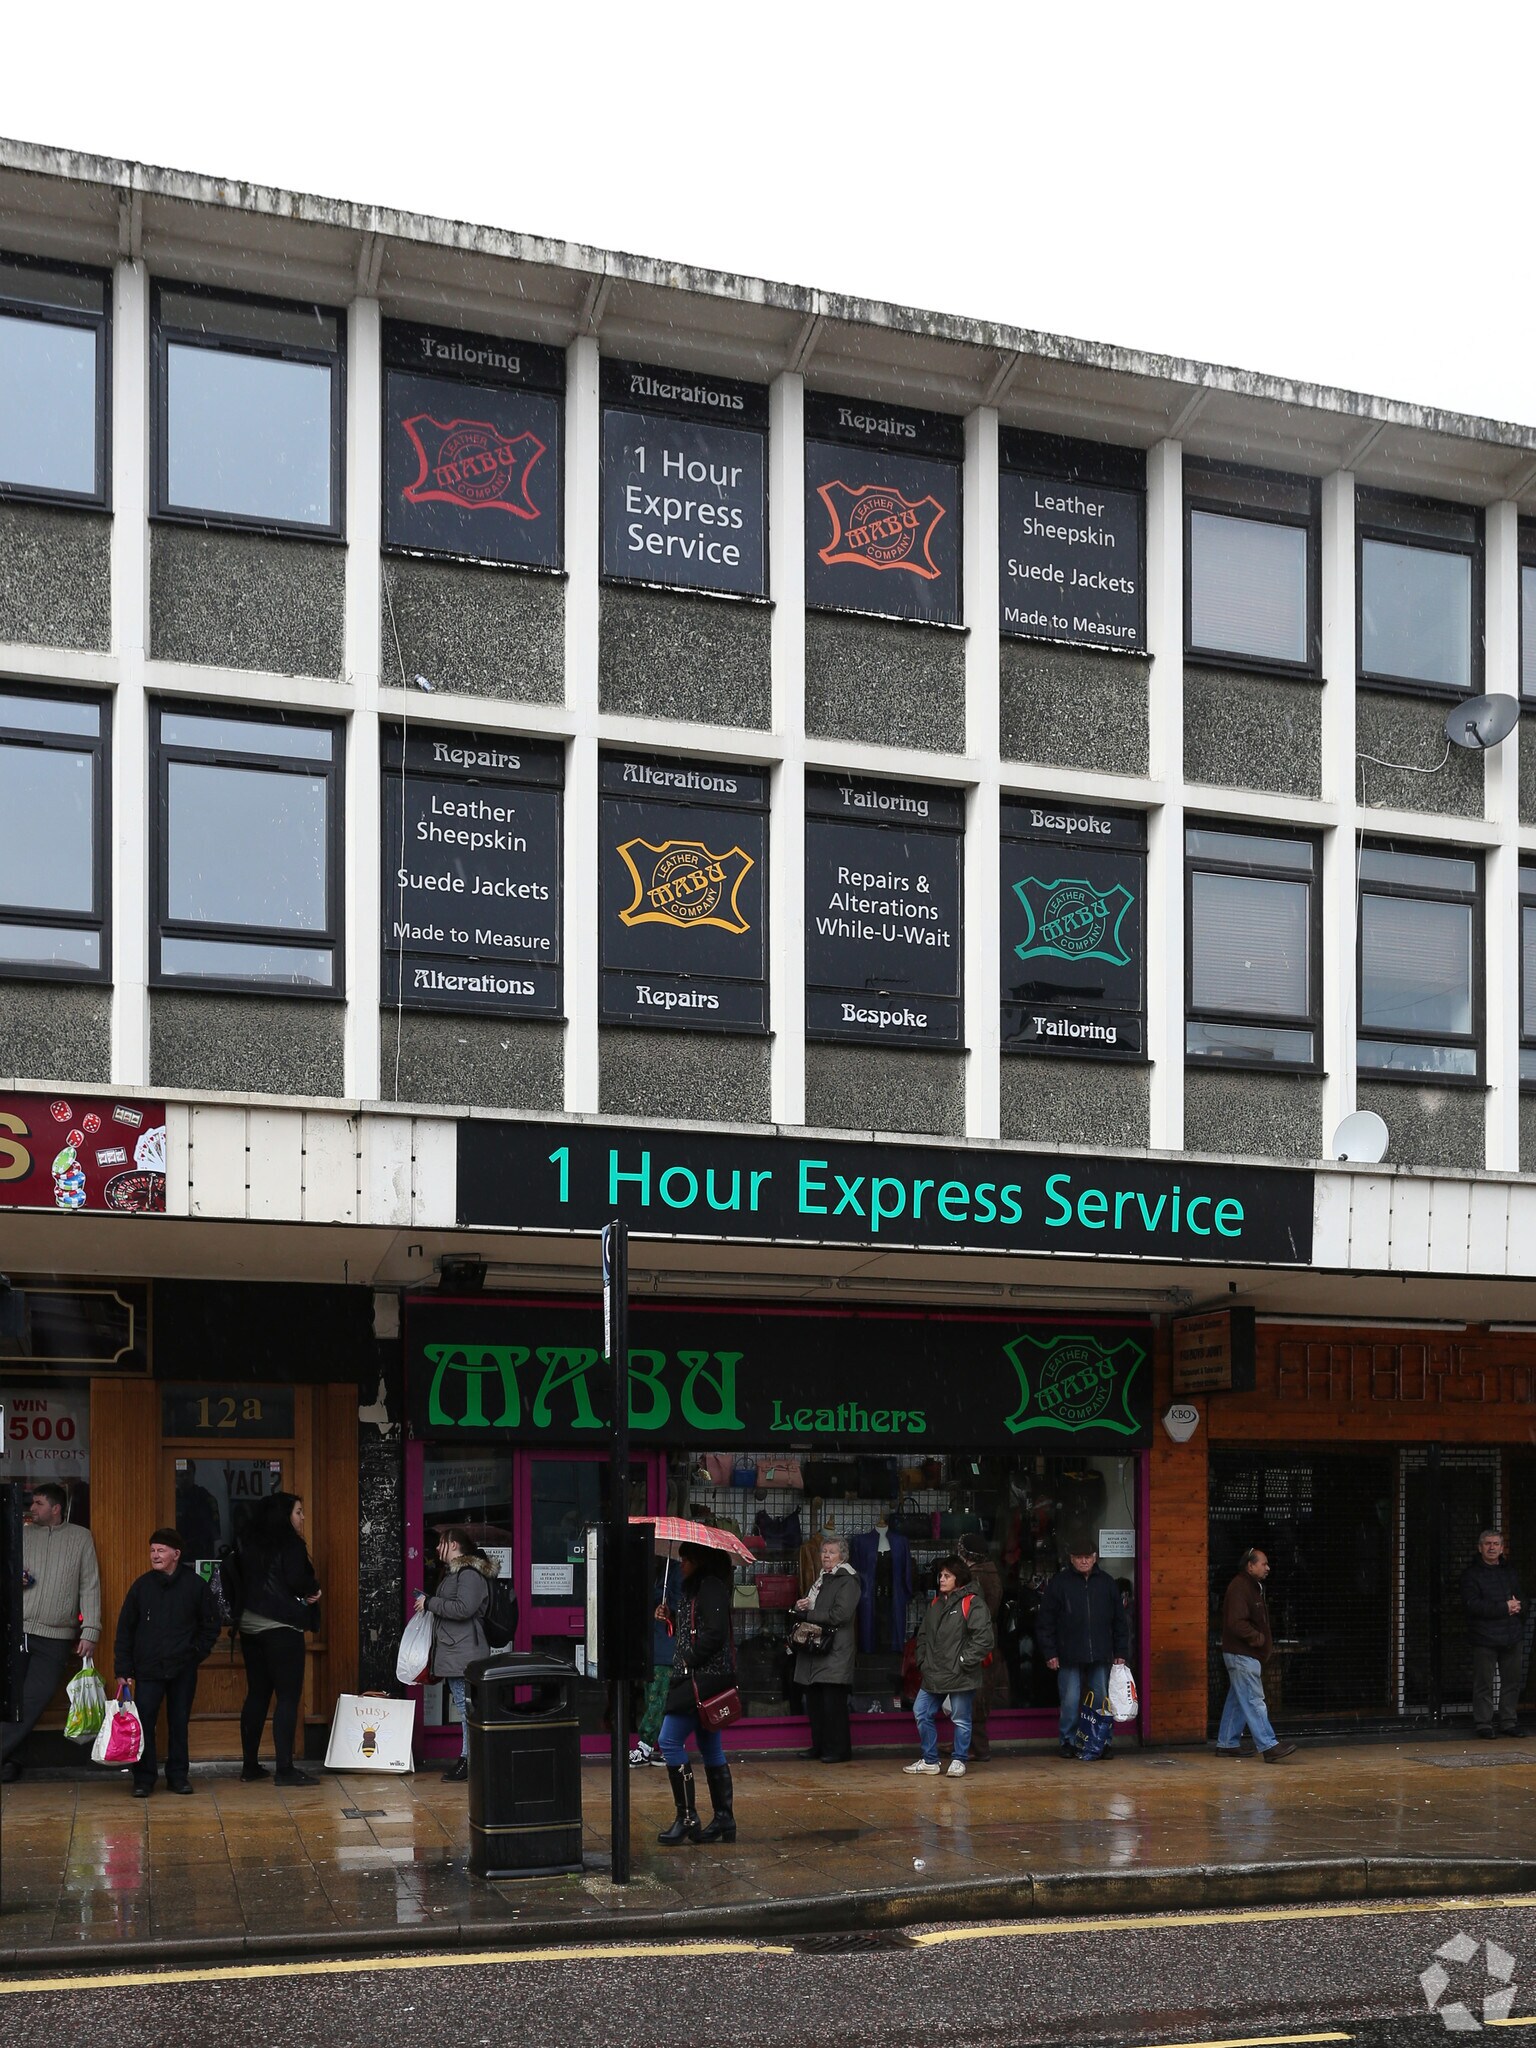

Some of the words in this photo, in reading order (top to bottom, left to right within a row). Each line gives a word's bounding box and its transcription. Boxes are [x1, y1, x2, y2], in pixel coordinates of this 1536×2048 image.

[420, 337, 521, 374] Tailoring
[629, 374, 745, 410] Alterations
[838, 408, 917, 438] Repairs
[444, 434, 488, 457] LEATHER
[432, 445, 518, 487] MABU
[634, 446, 646, 474] 1
[663, 452, 743, 489] Hour
[458, 471, 506, 498] COMPANY
[625, 485, 744, 530] Express
[854, 499, 894, 521] LEATHER
[1034, 491, 1105, 519] Leather
[844, 508, 920, 549] MABU
[1023, 517, 1116, 549] Sheepskin
[627, 524, 741, 567] Service
[867, 533, 911, 560] COMPANY
[1007, 558, 1065, 584] Suede
[1070, 564, 1136, 595] Jackets
[1004, 606, 1048, 628] Made
[1051, 614, 1069, 630] to
[1073, 615, 1137, 639] Measure
[433, 742, 521, 770] Repairs
[622, 763, 738, 794] Alterations
[431, 795, 516, 823] Leather
[839, 787, 929, 817] Tailoring
[1030, 809, 1112, 835] Bespoke
[416, 821, 527, 853] Sheepskin
[657, 854, 699, 879] LEATHER
[837, 867, 911, 893] Repairs
[916, 875, 931, 894] &
[397, 868, 465, 894] Suede
[471, 876, 550, 901] Jackets
[646, 861, 728, 908] MABU
[671, 888, 718, 917] COMPANY
[828, 892, 939, 921] Alterations
[1048, 892, 1085, 915] LEATHER
[816, 916, 951, 949] While-U-Wait
[1039, 898, 1111, 943] MABU
[393, 922, 444, 942] Made
[449, 927, 470, 944] to
[475, 929, 551, 951] Measure
[1060, 923, 1102, 951] COMPANY
[413, 969, 536, 997] Alterations
[636, 985, 720, 1010] Repairs
[841, 1003, 928, 1029] Bespoke
[1032, 1017, 1117, 1044] Tailoring
[548, 1146, 569, 1204] 1
[609, 1149, 773, 1211] Hour
[798, 1159, 1023, 1233] Express
[1044, 1173, 1246, 1238] Service
[1046, 1350, 1089, 1378] LEATHER
[423, 1343, 746, 1431] MABU
[769, 1401, 927, 1434] Leathers
[1033, 1356, 1119, 1412] MABU
[12, 1399, 48, 1412] WIN
[195, 1396, 264, 1428] 12a
[1059, 1386, 1108, 1419] COMPANY
[1171, 1409, 1191, 1419] KBO
[20, 1449, 86, 1460] JACKPOTS
[354, 1706, 390, 1721] busy
